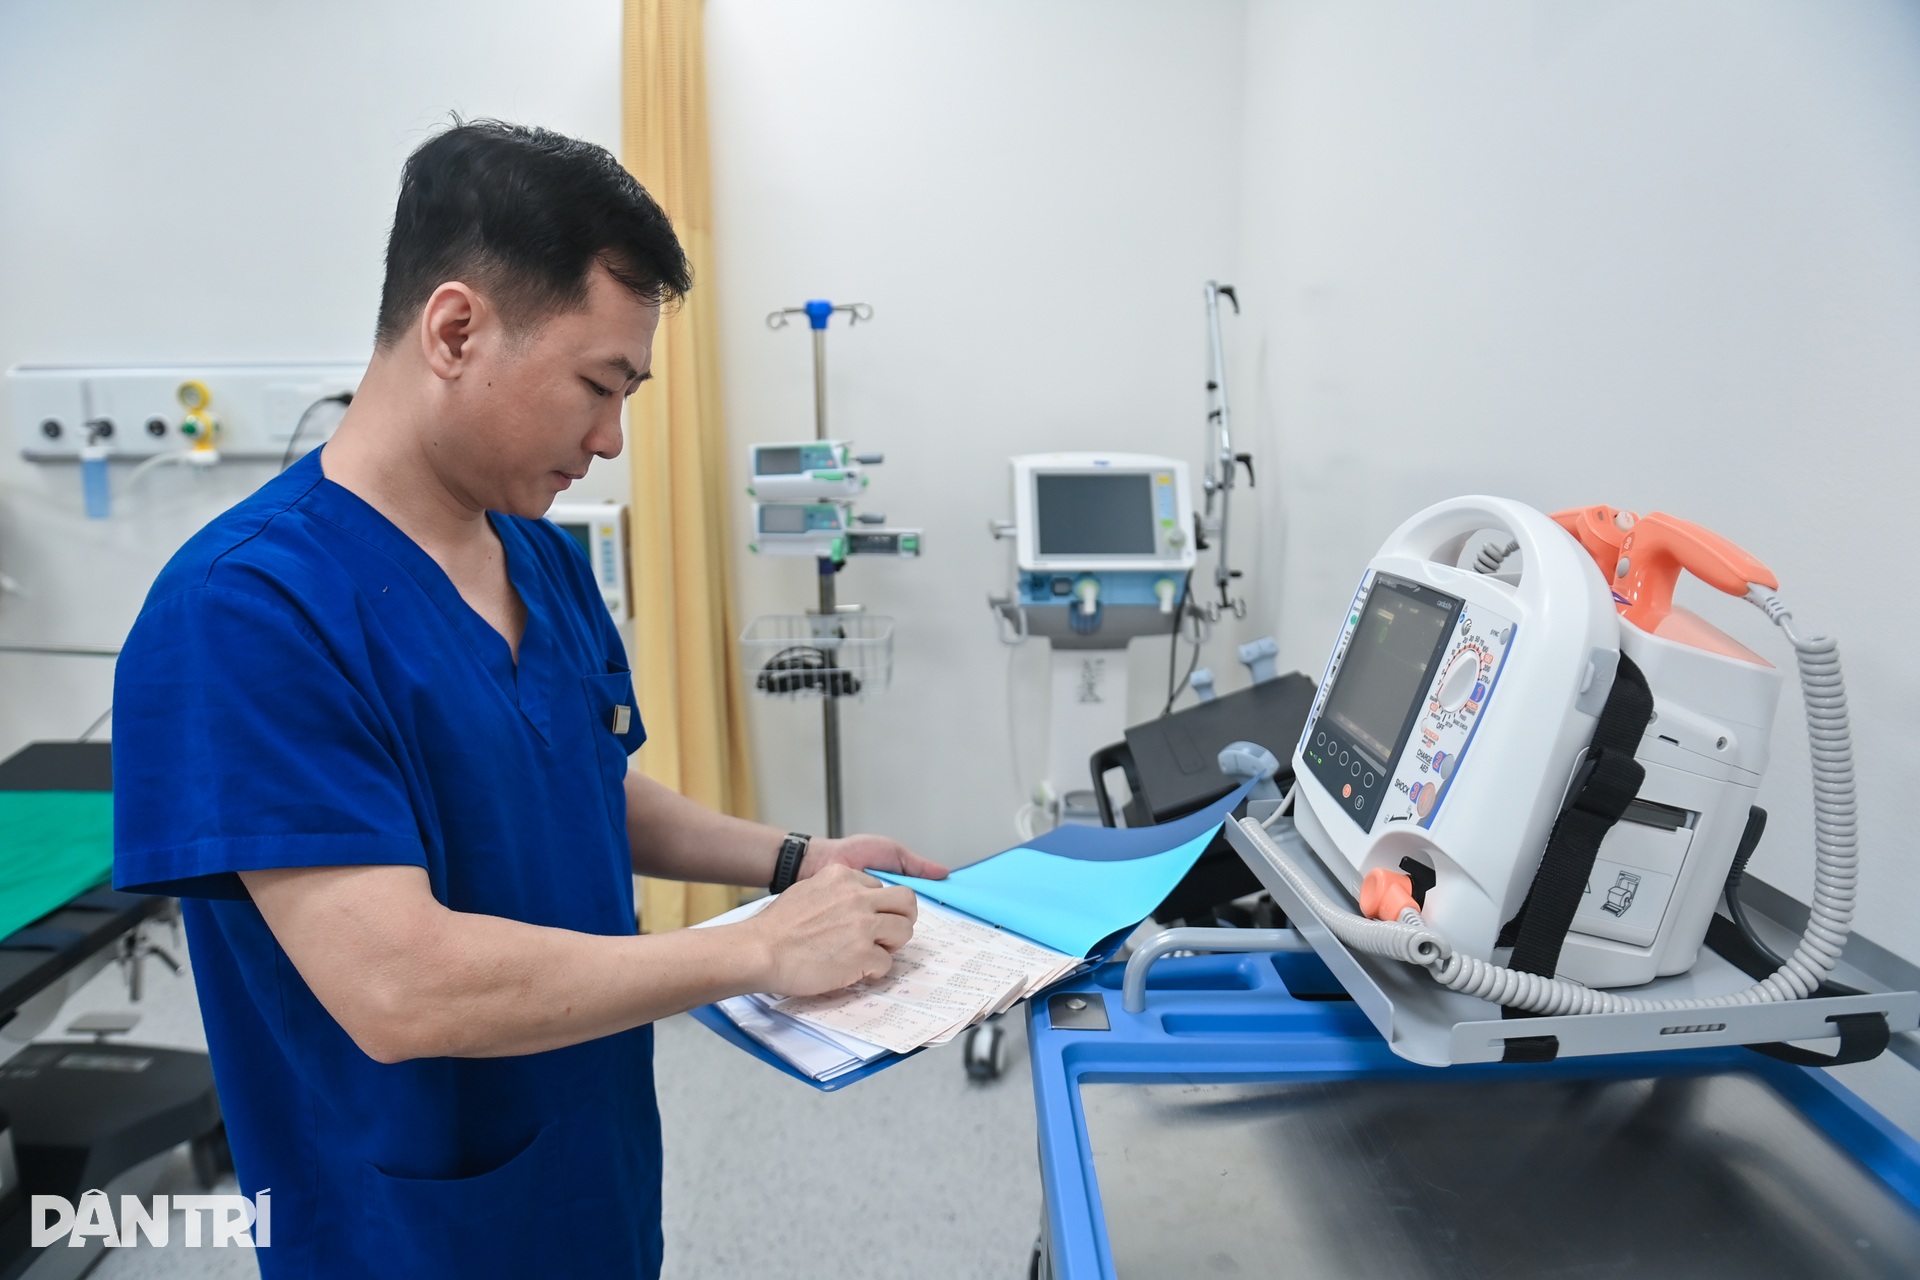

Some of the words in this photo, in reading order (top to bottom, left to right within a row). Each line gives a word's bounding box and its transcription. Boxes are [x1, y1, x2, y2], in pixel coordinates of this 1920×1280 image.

[1462, 636, 1469, 644] 20
[1474, 635, 1481, 643] 50
[1482, 663, 1491, 673] 200
[1475, 685, 1483, 701] 1
[1435, 722, 1445, 731] OFF
[1416, 748, 1433, 764] CHARGE
[1433, 752, 1443, 769] 2
[1420, 763, 1429, 774] AED
[1394, 778, 1410, 796] SHOCK
[1410, 783, 1420, 800] 3
